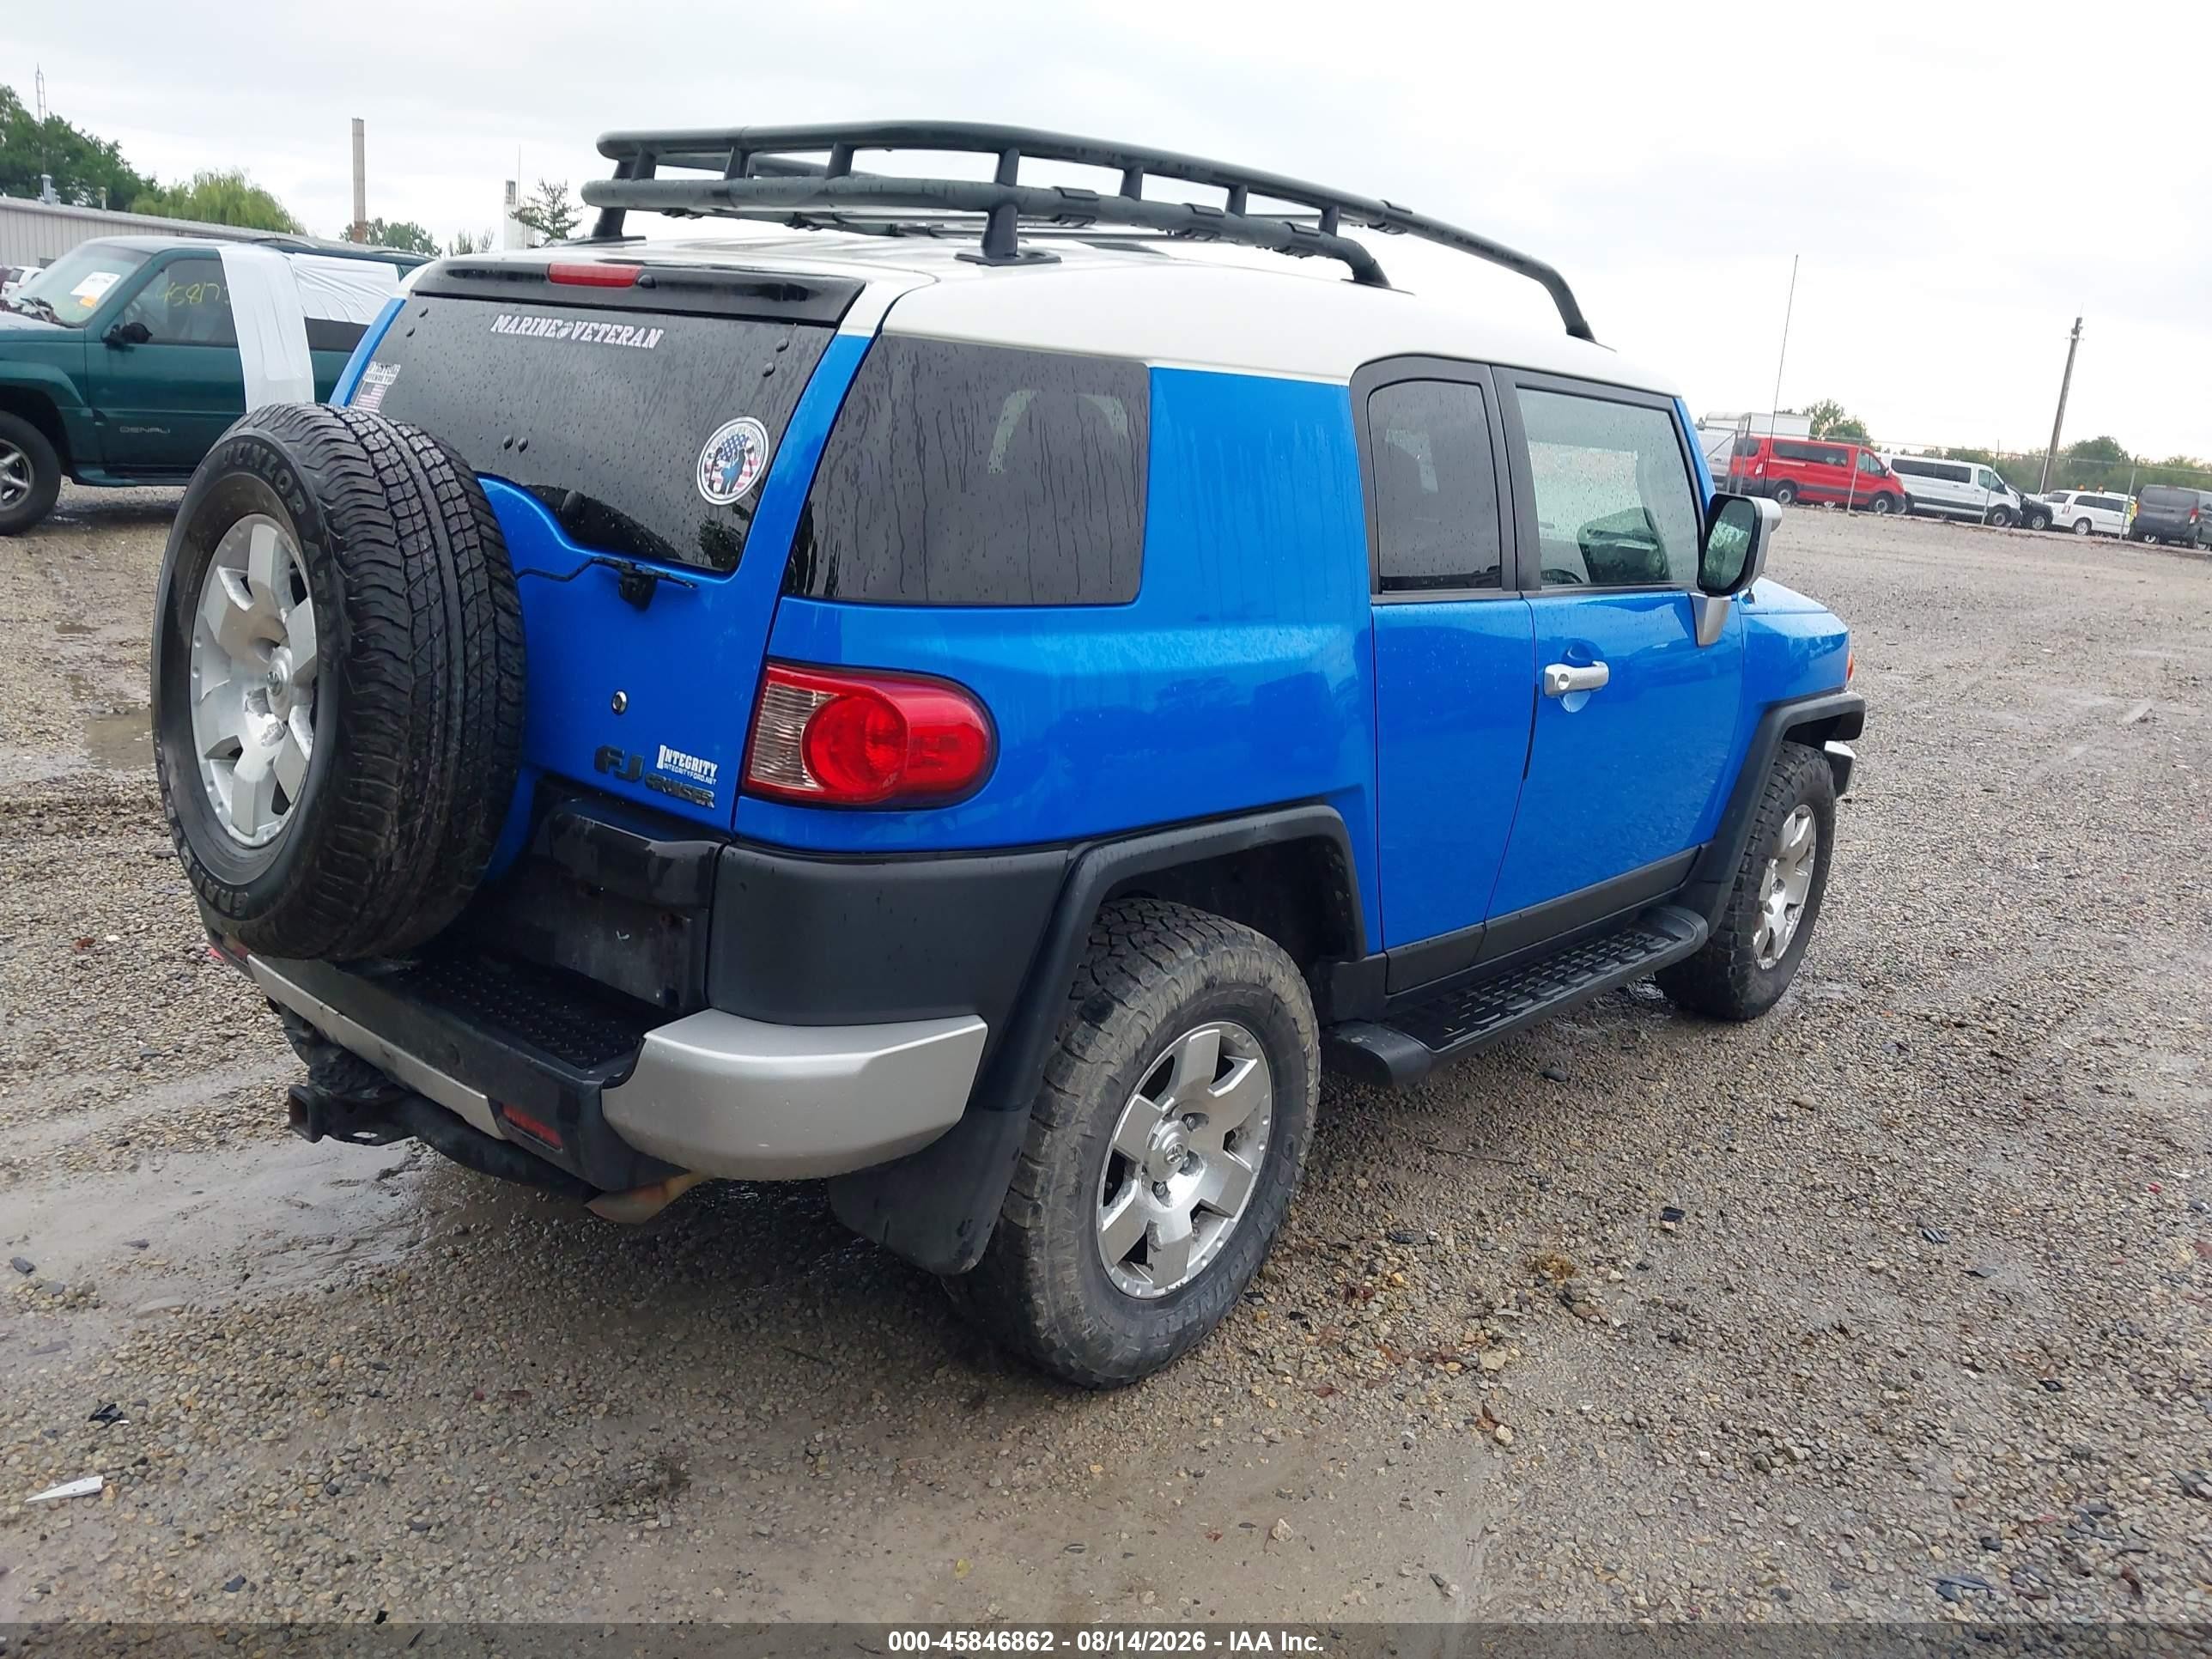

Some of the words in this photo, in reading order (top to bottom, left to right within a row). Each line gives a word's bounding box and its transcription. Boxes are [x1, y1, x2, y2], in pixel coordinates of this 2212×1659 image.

[490, 314, 563, 338] MARINE
[571, 320, 665, 350] VETERAN
[223, 442, 306, 515] DUNLOP
[594, 744, 644, 783] FJ
[645, 773, 715, 809] CRUISER
[656, 744, 718, 777] INTEGRITY
